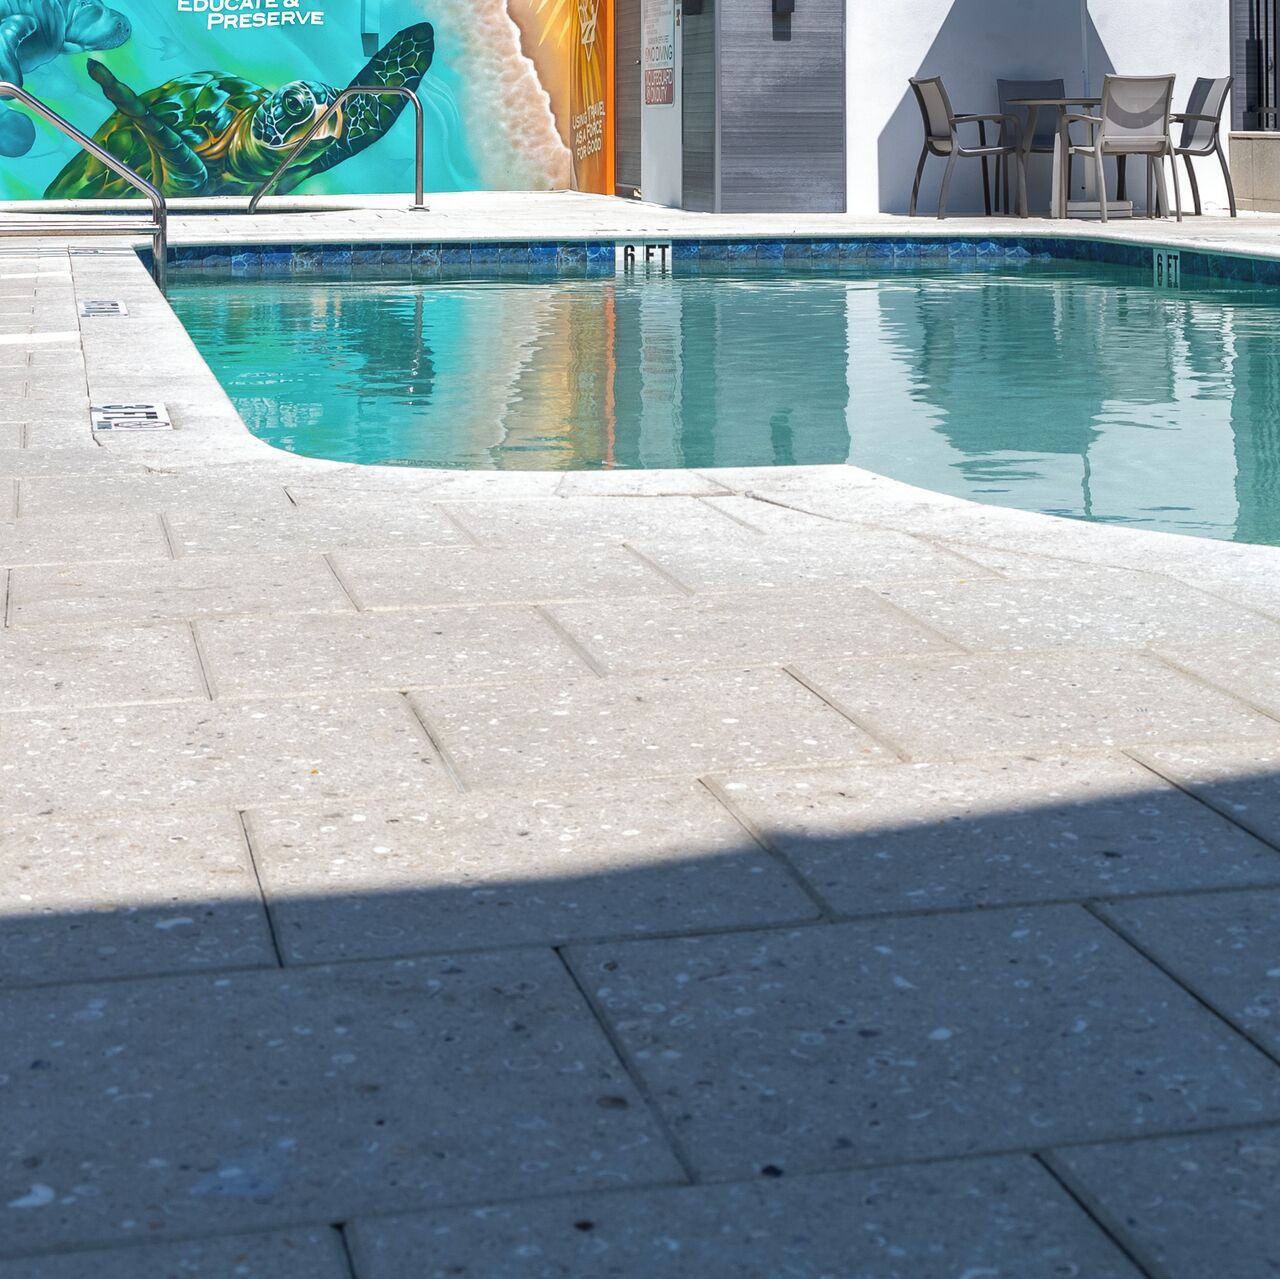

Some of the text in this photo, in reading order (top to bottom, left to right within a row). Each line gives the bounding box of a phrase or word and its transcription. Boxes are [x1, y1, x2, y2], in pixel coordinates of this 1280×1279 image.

[208, 11, 324, 30] PRESERVE
[572, 101, 605, 130] USING TRAVEL
[575, 130, 582, 145] AS
[587, 120, 602, 140] FORCE
[577, 138, 601, 160] FOR GOOD
[623, 244, 669, 273] 6 FT
[1167, 254, 1178, 277] FT
